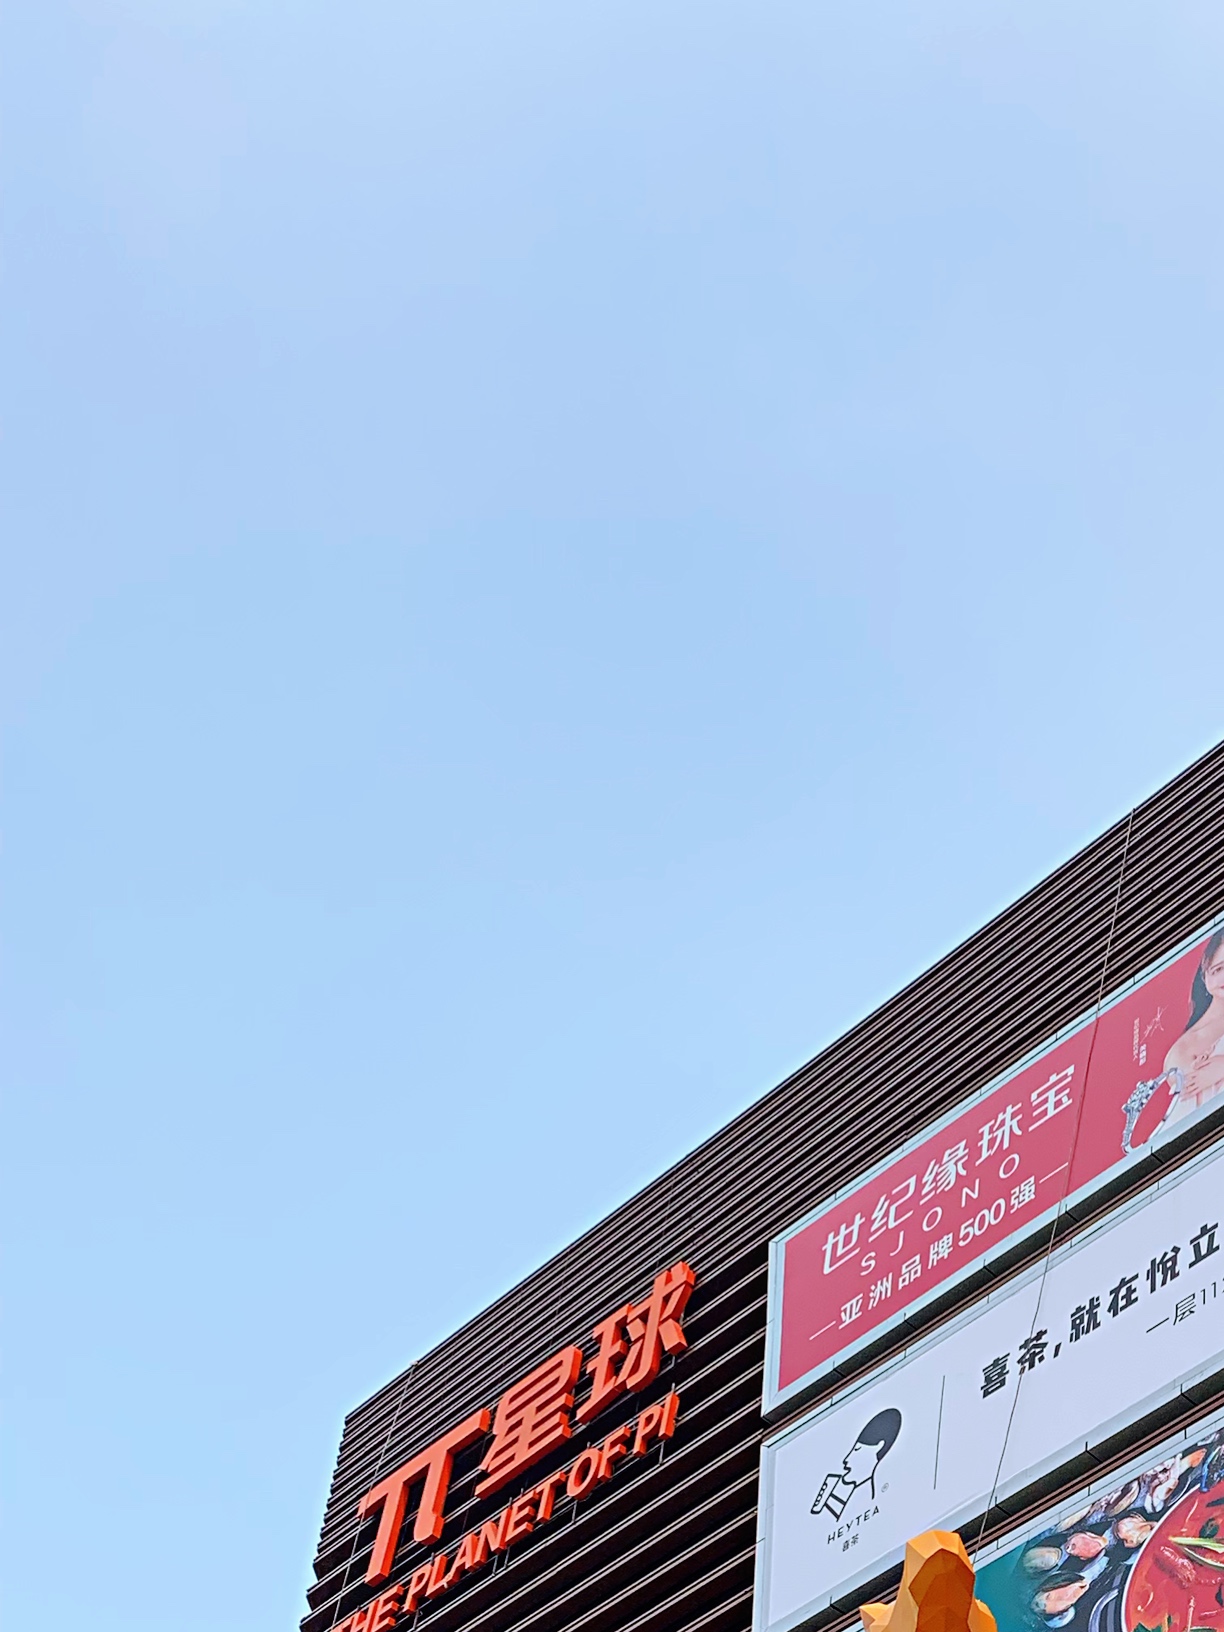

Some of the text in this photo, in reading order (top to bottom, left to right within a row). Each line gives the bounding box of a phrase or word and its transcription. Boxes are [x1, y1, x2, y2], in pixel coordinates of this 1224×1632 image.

[822, 1064, 1075, 1275] 世纪缘珠宝
[860, 1153, 1020, 1276] SJONO
[838, 1175, 1036, 1329] 亚洲品牌500强
[402, 1471, 567, 1614] PLANET
[566, 1426, 632, 1501] OF
[632, 1392, 681, 1458] PI
[827, 1505, 880, 1545] HEYTEA
